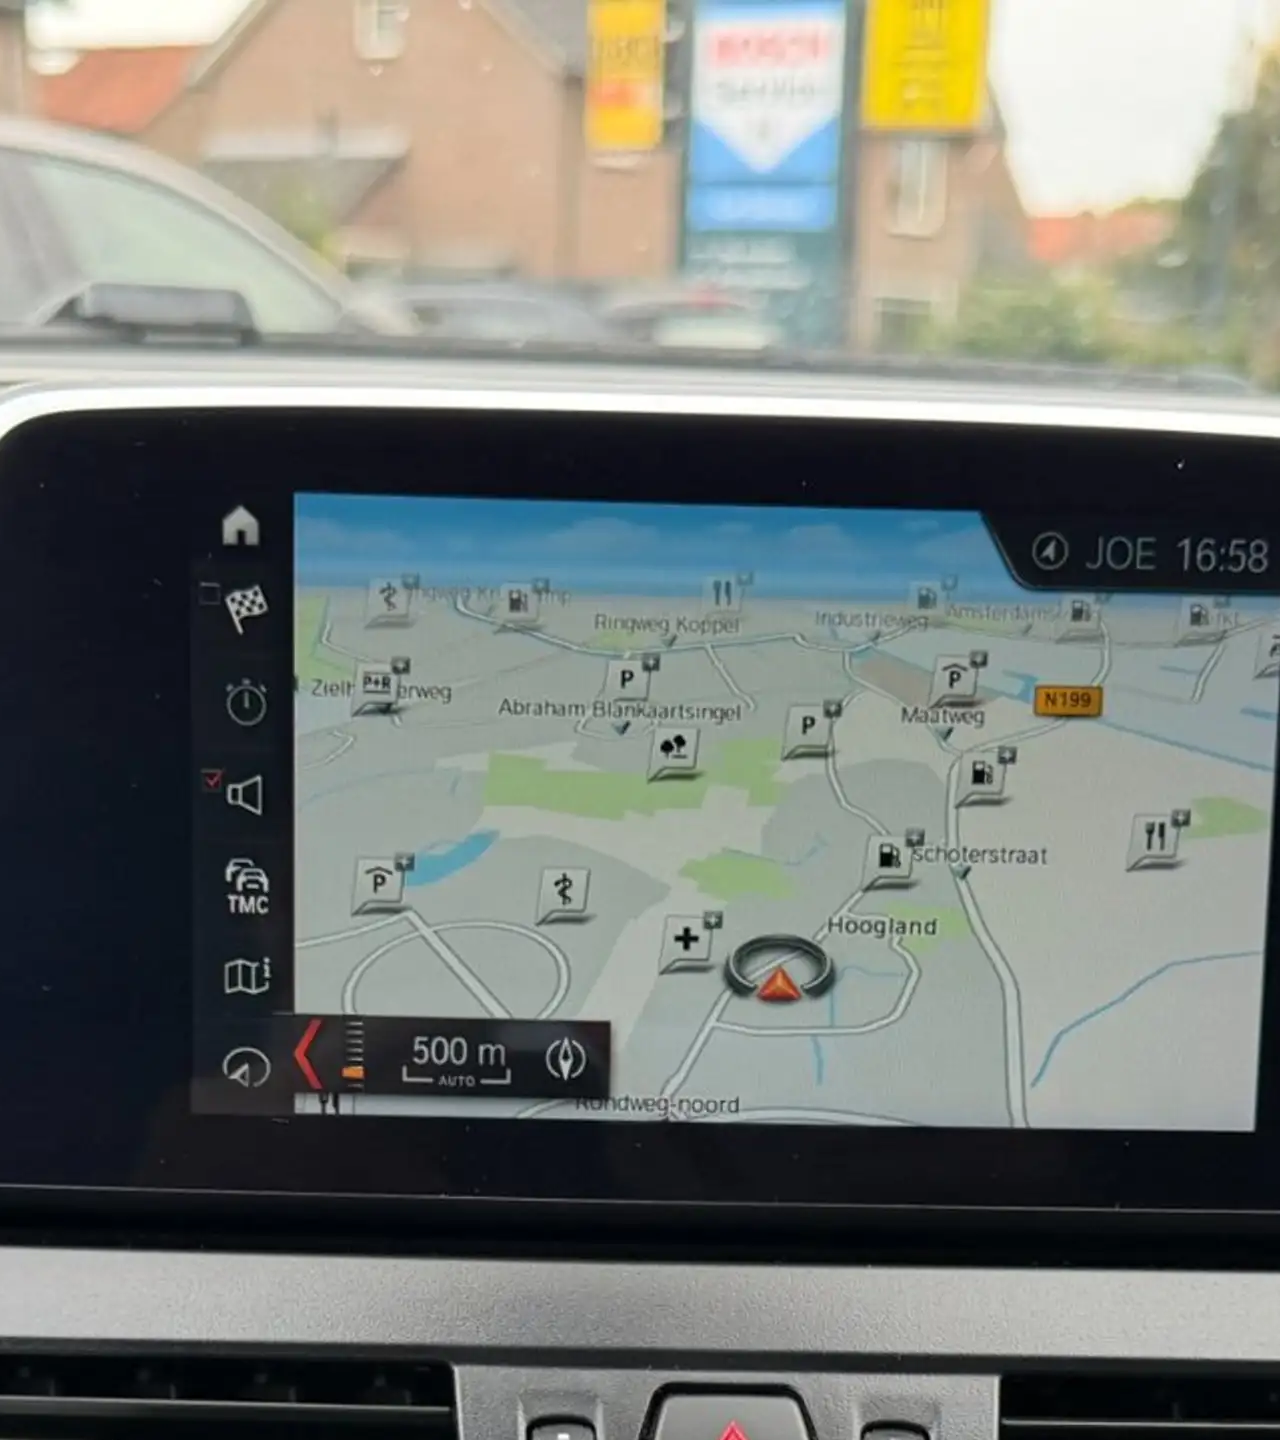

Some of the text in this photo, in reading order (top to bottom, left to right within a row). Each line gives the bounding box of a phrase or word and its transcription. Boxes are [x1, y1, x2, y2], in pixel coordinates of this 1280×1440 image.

[1086, 536, 1268, 573] JOE 16:58
[594, 613, 740, 635] Ringweg Koppel
[815, 608, 929, 631] Industrieweg
[498, 697, 742, 725] Abraham Blankaartsingel
[1043, 691, 1092, 709] N199
[901, 706, 985, 729] Maatweg
[228, 894, 268, 914] TMC
[827, 915, 938, 939] Hoogland
[413, 1036, 505, 1065] 500 m
[438, 1075, 475, 1087] AUTO
[574, 1094, 740, 1117] Rondweg-noord
